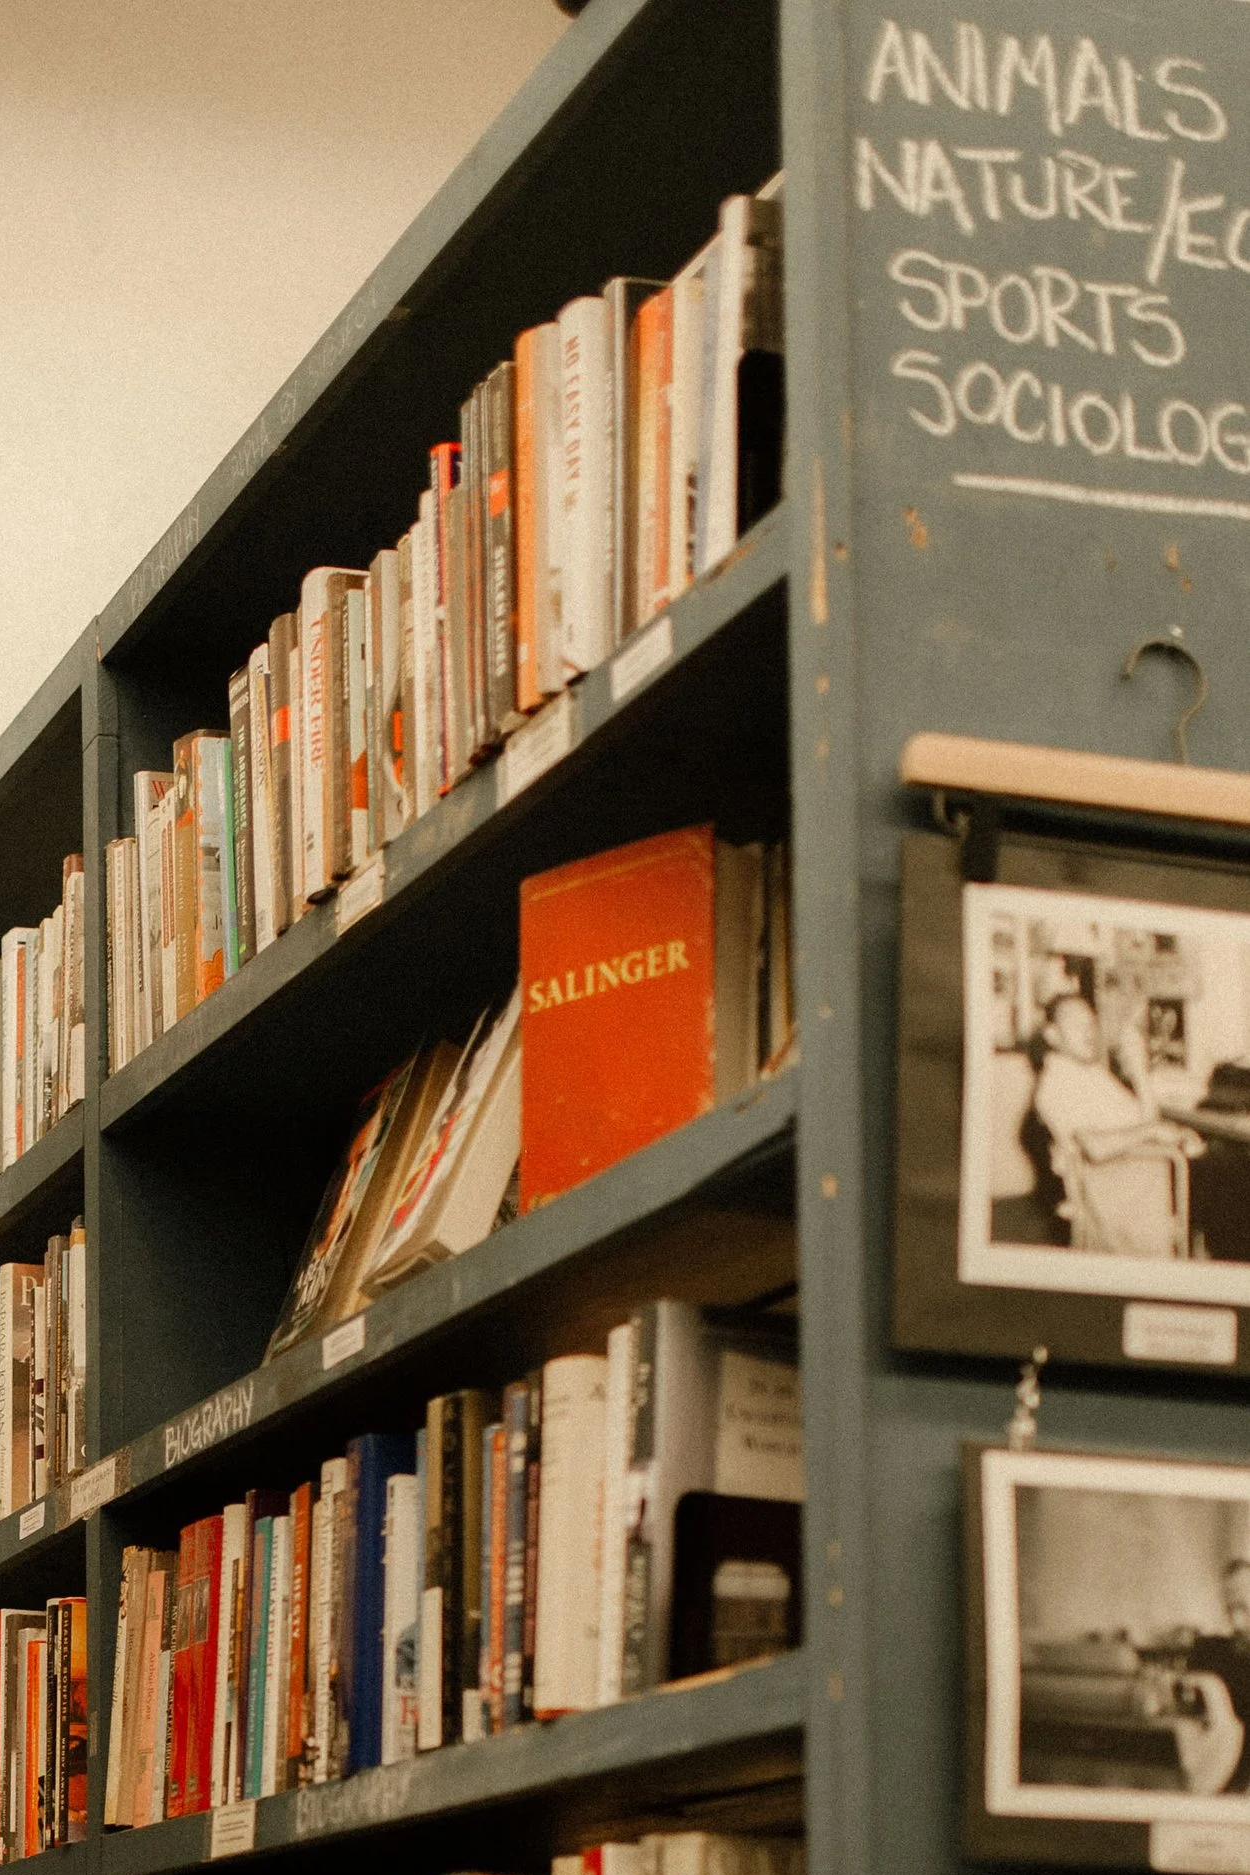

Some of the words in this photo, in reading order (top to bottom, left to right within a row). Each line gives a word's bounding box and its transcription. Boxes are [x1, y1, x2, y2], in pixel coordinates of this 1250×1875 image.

[866, 17, 1230, 145] ANIMALS
[887, 247, 1187, 370] SPORTS
[564, 335, 580, 367] NO
[564, 375, 580, 430] EASY
[564, 439, 580, 482] DAY
[494, 545, 507, 618] STOLEN
[309, 619, 323, 704] UNDER
[494, 620, 507, 677] LIVES
[309, 711, 322, 770] FIRE
[237, 754, 246, 830] ARROGANCE
[528, 940, 691, 1014] SALINGER
[0, 1290, 7, 1360] BARBARA
[0, 1366, 8, 1434] JORDAN
[163, 1378, 254, 1468] BIOGRAPHY
[62, 1610, 70, 1663] CHANEL
[62, 1666, 70, 1724] BONFIRE
